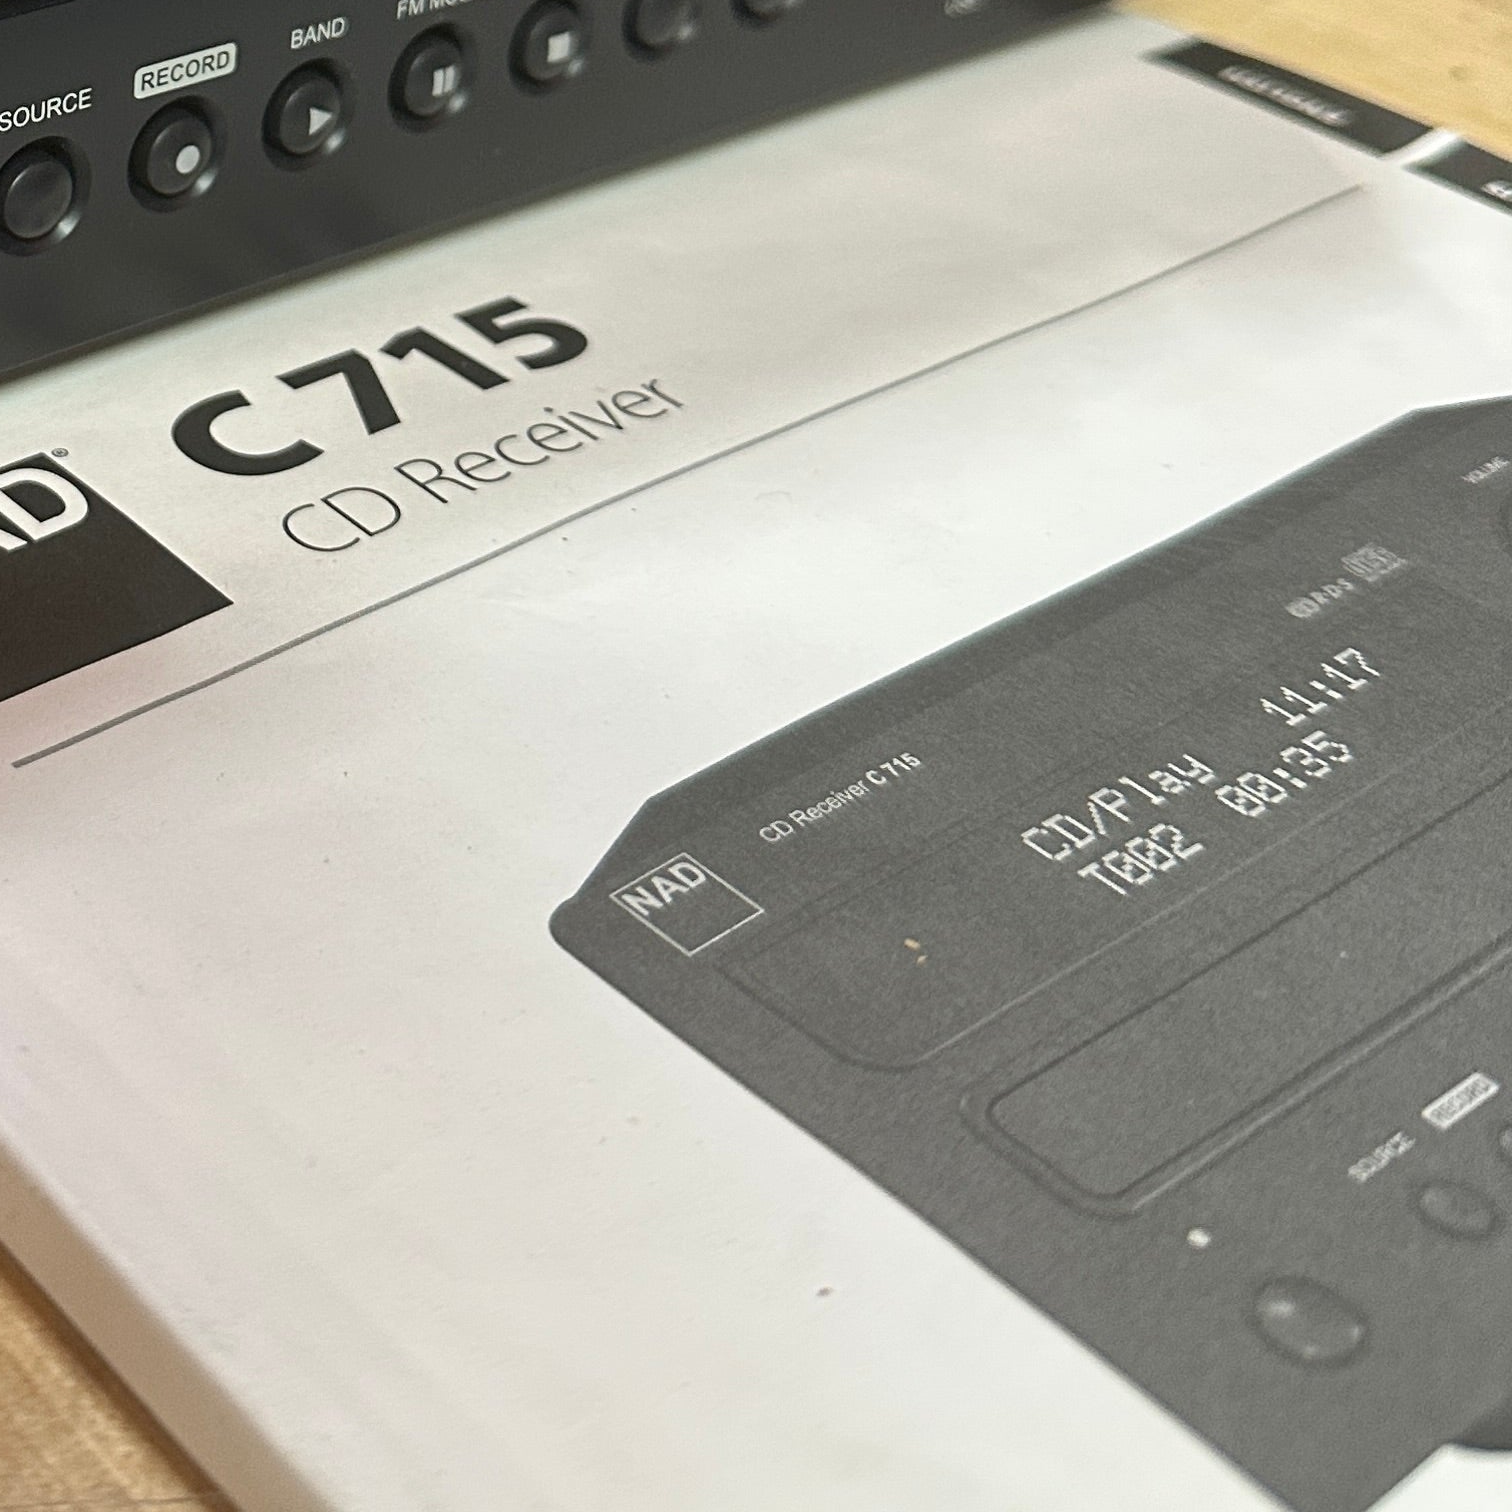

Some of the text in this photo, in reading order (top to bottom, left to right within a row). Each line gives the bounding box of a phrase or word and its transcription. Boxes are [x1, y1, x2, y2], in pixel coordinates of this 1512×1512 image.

[140, 50, 231, 90] RECORD
[290, 18, 346, 50] BAND
[170, 296, 589, 477] C 715
[281, 376, 686, 553] CD Receiver
[759, 752, 922, 843] CD Receiver C 715
[1021, 647, 1381, 862] CD/Play 11:17
[1077, 730, 1354, 896] T002 00:35
[621, 861, 708, 917] NAD
